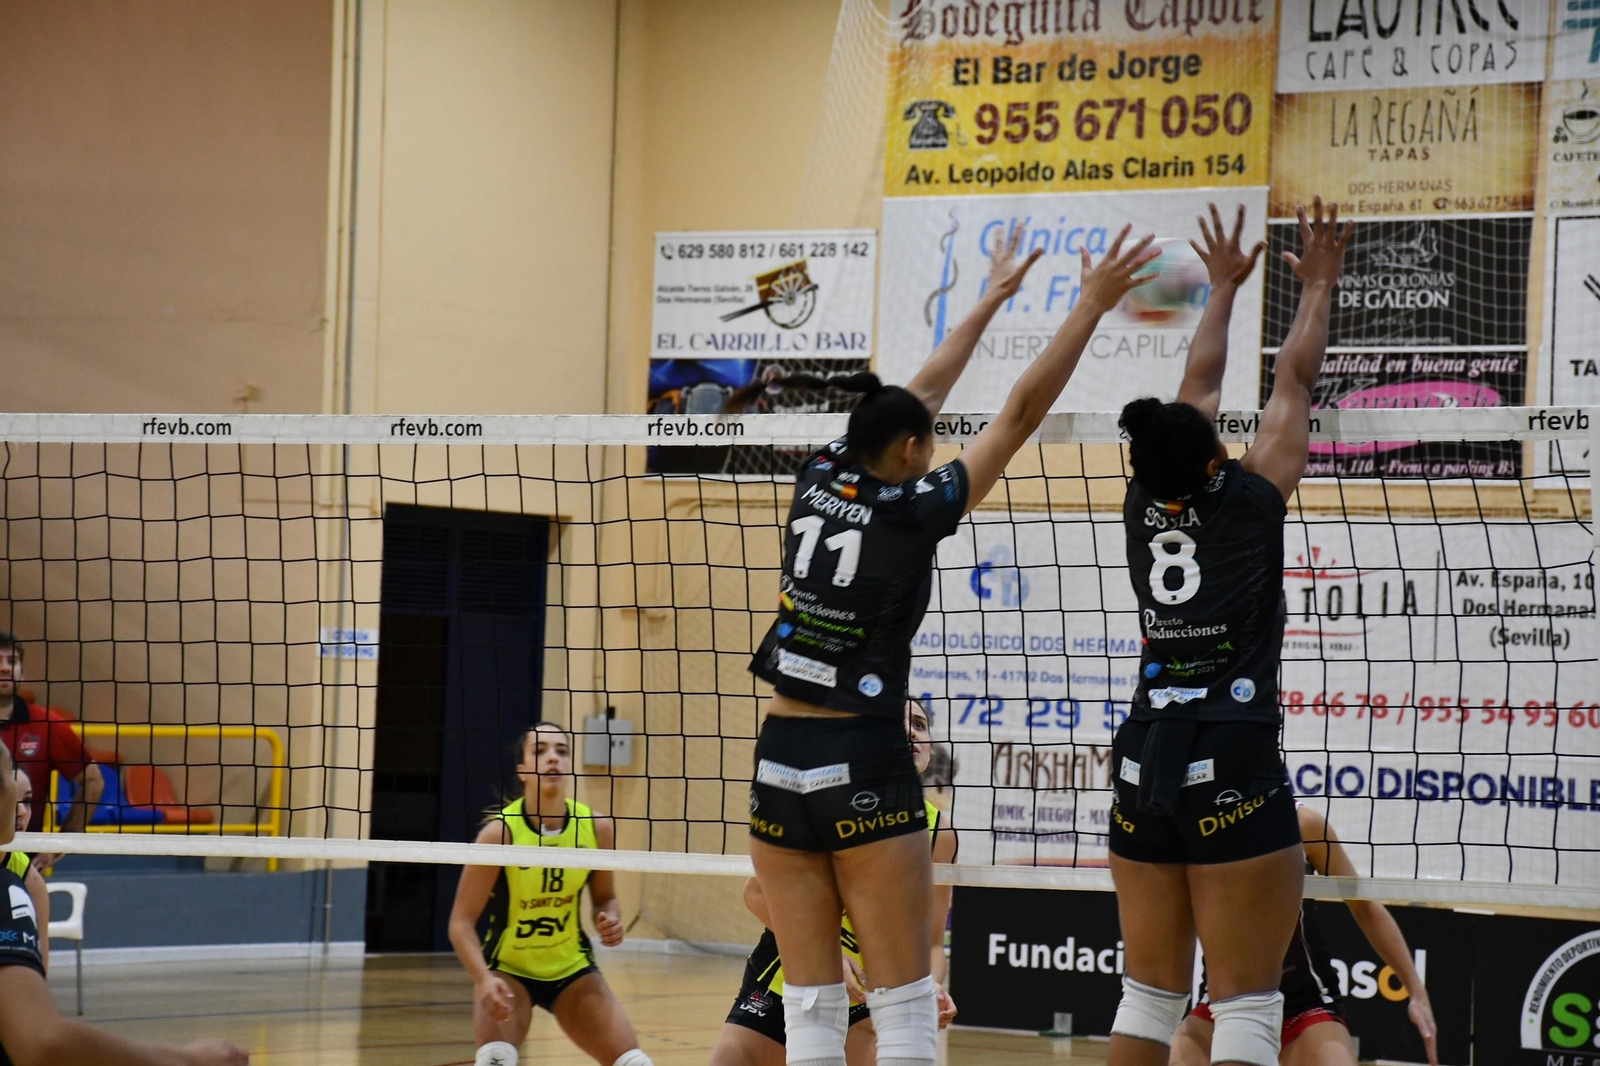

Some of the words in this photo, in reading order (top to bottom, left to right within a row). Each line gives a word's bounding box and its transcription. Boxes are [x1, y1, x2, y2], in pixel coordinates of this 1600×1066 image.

[953, 57, 980, 86] El
[993, 55, 1048, 85] Bar
[1058, 54, 1097, 82] de
[1108, 51, 1203, 84] Jorge
[1393, 47, 1408, 77] &
[1430, 40, 1518, 75] COPAS
[975, 101, 1060, 145] 955
[1075, 97, 1146, 142] 671
[1161, 93, 1254, 138] 050
[1331, 99, 1359, 148] LA
[1369, 86, 1479, 146] REGAÑÁ
[1368, 147, 1430, 161] TAPAS
[905, 165, 940, 186] Av.
[948, 161, 1055, 188] Leopoldo
[1063, 159, 1114, 182] Alas
[1205, 154, 1247, 176] 154
[1379, 178, 1453, 194] HERMANAS
[678, 244, 704, 259] 629
[708, 243, 735, 259] 580
[739, 243, 765, 258] 812
[769, 243, 775, 258] /
[779, 242, 804, 258] 661
[810, 242, 837, 258] 228
[843, 241, 869, 257] 142
[979, 216, 1108, 258] Clínica
[1339, 291, 1361, 308] DE
[1364, 288, 1450, 309] GALEON
[657, 333, 684, 350] EL
[689, 332, 808, 351] CARRILLO
[816, 332, 867, 350] BAR
[1090, 333, 1192, 359] CAPILA
[1320, 355, 1383, 373] ialidad
[1385, 359, 1408, 373] en
[1411, 355, 1465, 373] buena
[1467, 357, 1519, 378] gente
[142, 418, 232, 437] rfevb.com
[391, 418, 483, 437] rfevb.com
[647, 418, 744, 437] rfevb.com
[933, 416, 989, 436] evb.c
[1528, 410, 1590, 431] rfevb
[801, 484, 873, 526] MERIYEN
[791, 515, 863, 588] 11
[1148, 530, 1201, 605] 8
[1456, 570, 1484, 588] Av.
[1491, 570, 1566, 592] España,
[1282, 579, 1418, 624] TOLIA
[1462, 600, 1497, 616] Dos
[1030, 635, 1065, 652] DOS
[1073, 637, 1139, 654] HERMA
[1489, 625, 1571, 650] (Sevilla)
[1041, 671, 1063, 684] Dos
[956, 693, 1004, 726] 72
[1025, 696, 1081, 729] 29
[1103, 698, 1128, 731] 5
[1312, 692, 1346, 718] 66
[1355, 694, 1388, 720] 78
[1397, 692, 1409, 725] /
[1418, 696, 1470, 724] 955
[1481, 697, 1515, 726] 54
[1524, 700, 1558, 728] 95
[836, 810, 910, 839] Divisa
[1198, 795, 1265, 837] Divisa
[516, 910, 571, 938] DSV
[987, 933, 1125, 974] Fundaci
